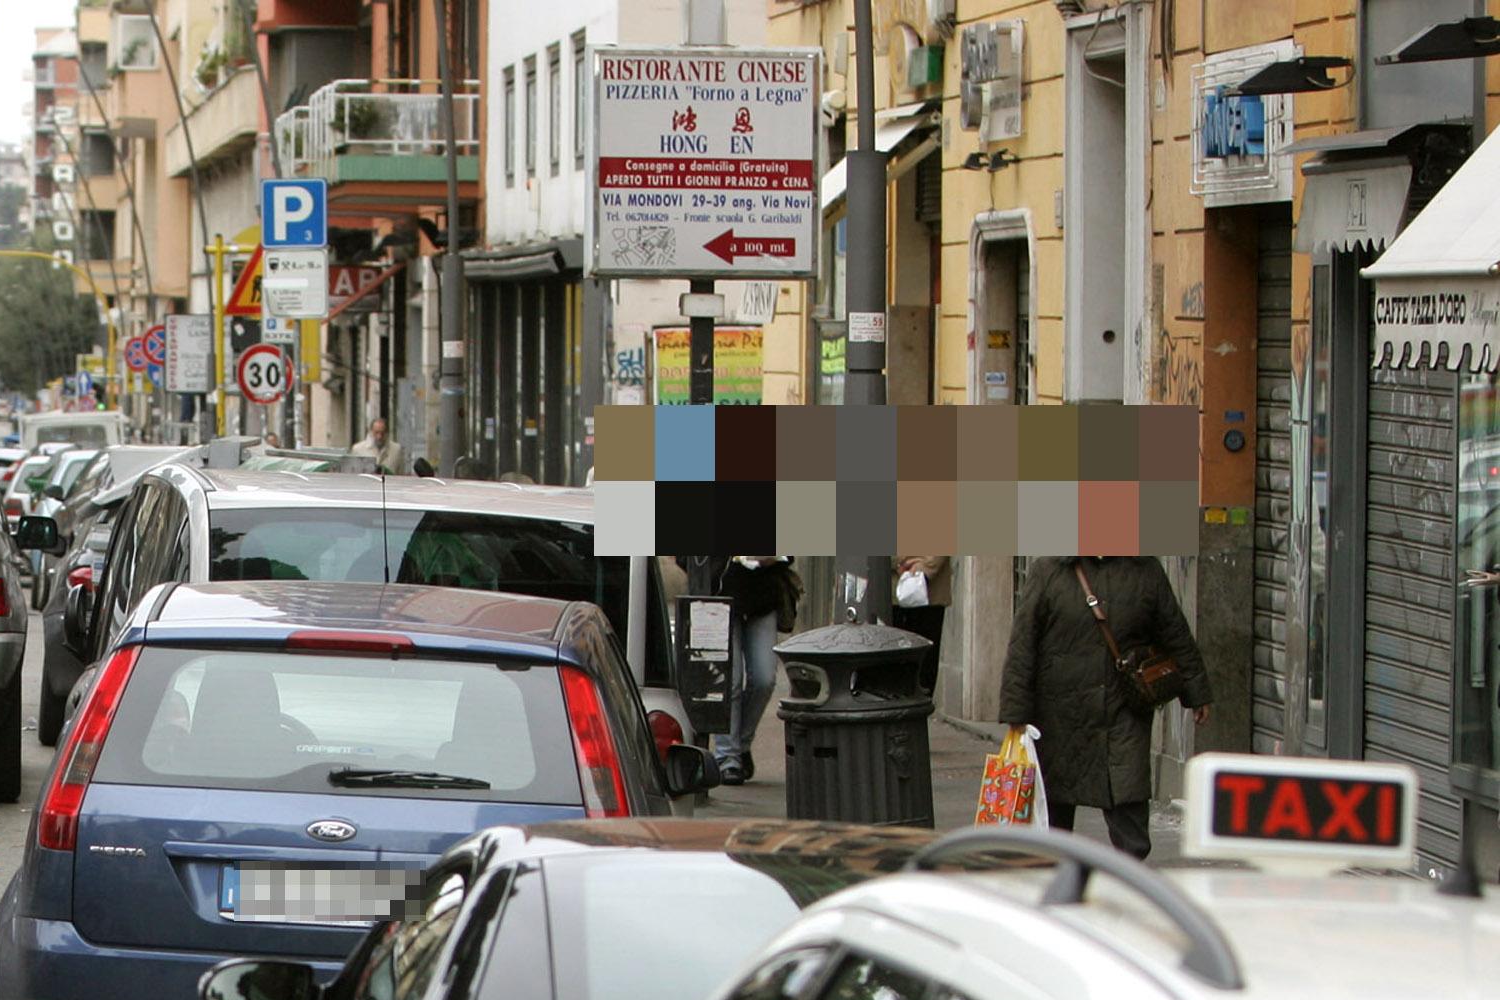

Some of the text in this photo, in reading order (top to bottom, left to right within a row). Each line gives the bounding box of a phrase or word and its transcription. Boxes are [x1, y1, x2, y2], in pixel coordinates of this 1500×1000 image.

[603, 59, 807, 83] RISTORANTE CINESE
[606, 84, 809, 106] PIZZERIA "Forno a Legna"
[660, 134, 754, 154] HONG EN
[689, 160, 736, 172] domicilio
[739, 161, 789, 175] (Gratuito)
[605, 174, 809, 188] APERTO TUTTI I GIORNI PRANZO e CENA
[603, 194, 810, 210] VIA MONDOVI 29-39 ang. Via Novi
[273, 186, 314, 241] P
[716, 213, 743, 223] scuola
[761, 214, 802, 224] Garibaldi
[729, 244, 737, 252] a
[744, 243, 763, 253] 100
[1411, 295, 1437, 325] TAZZA
[249, 362, 281, 388] 30
[1216, 775, 1397, 843] TAXI
[315, 822, 346, 839] Ford
[89, 845, 147, 857] FIESTA
